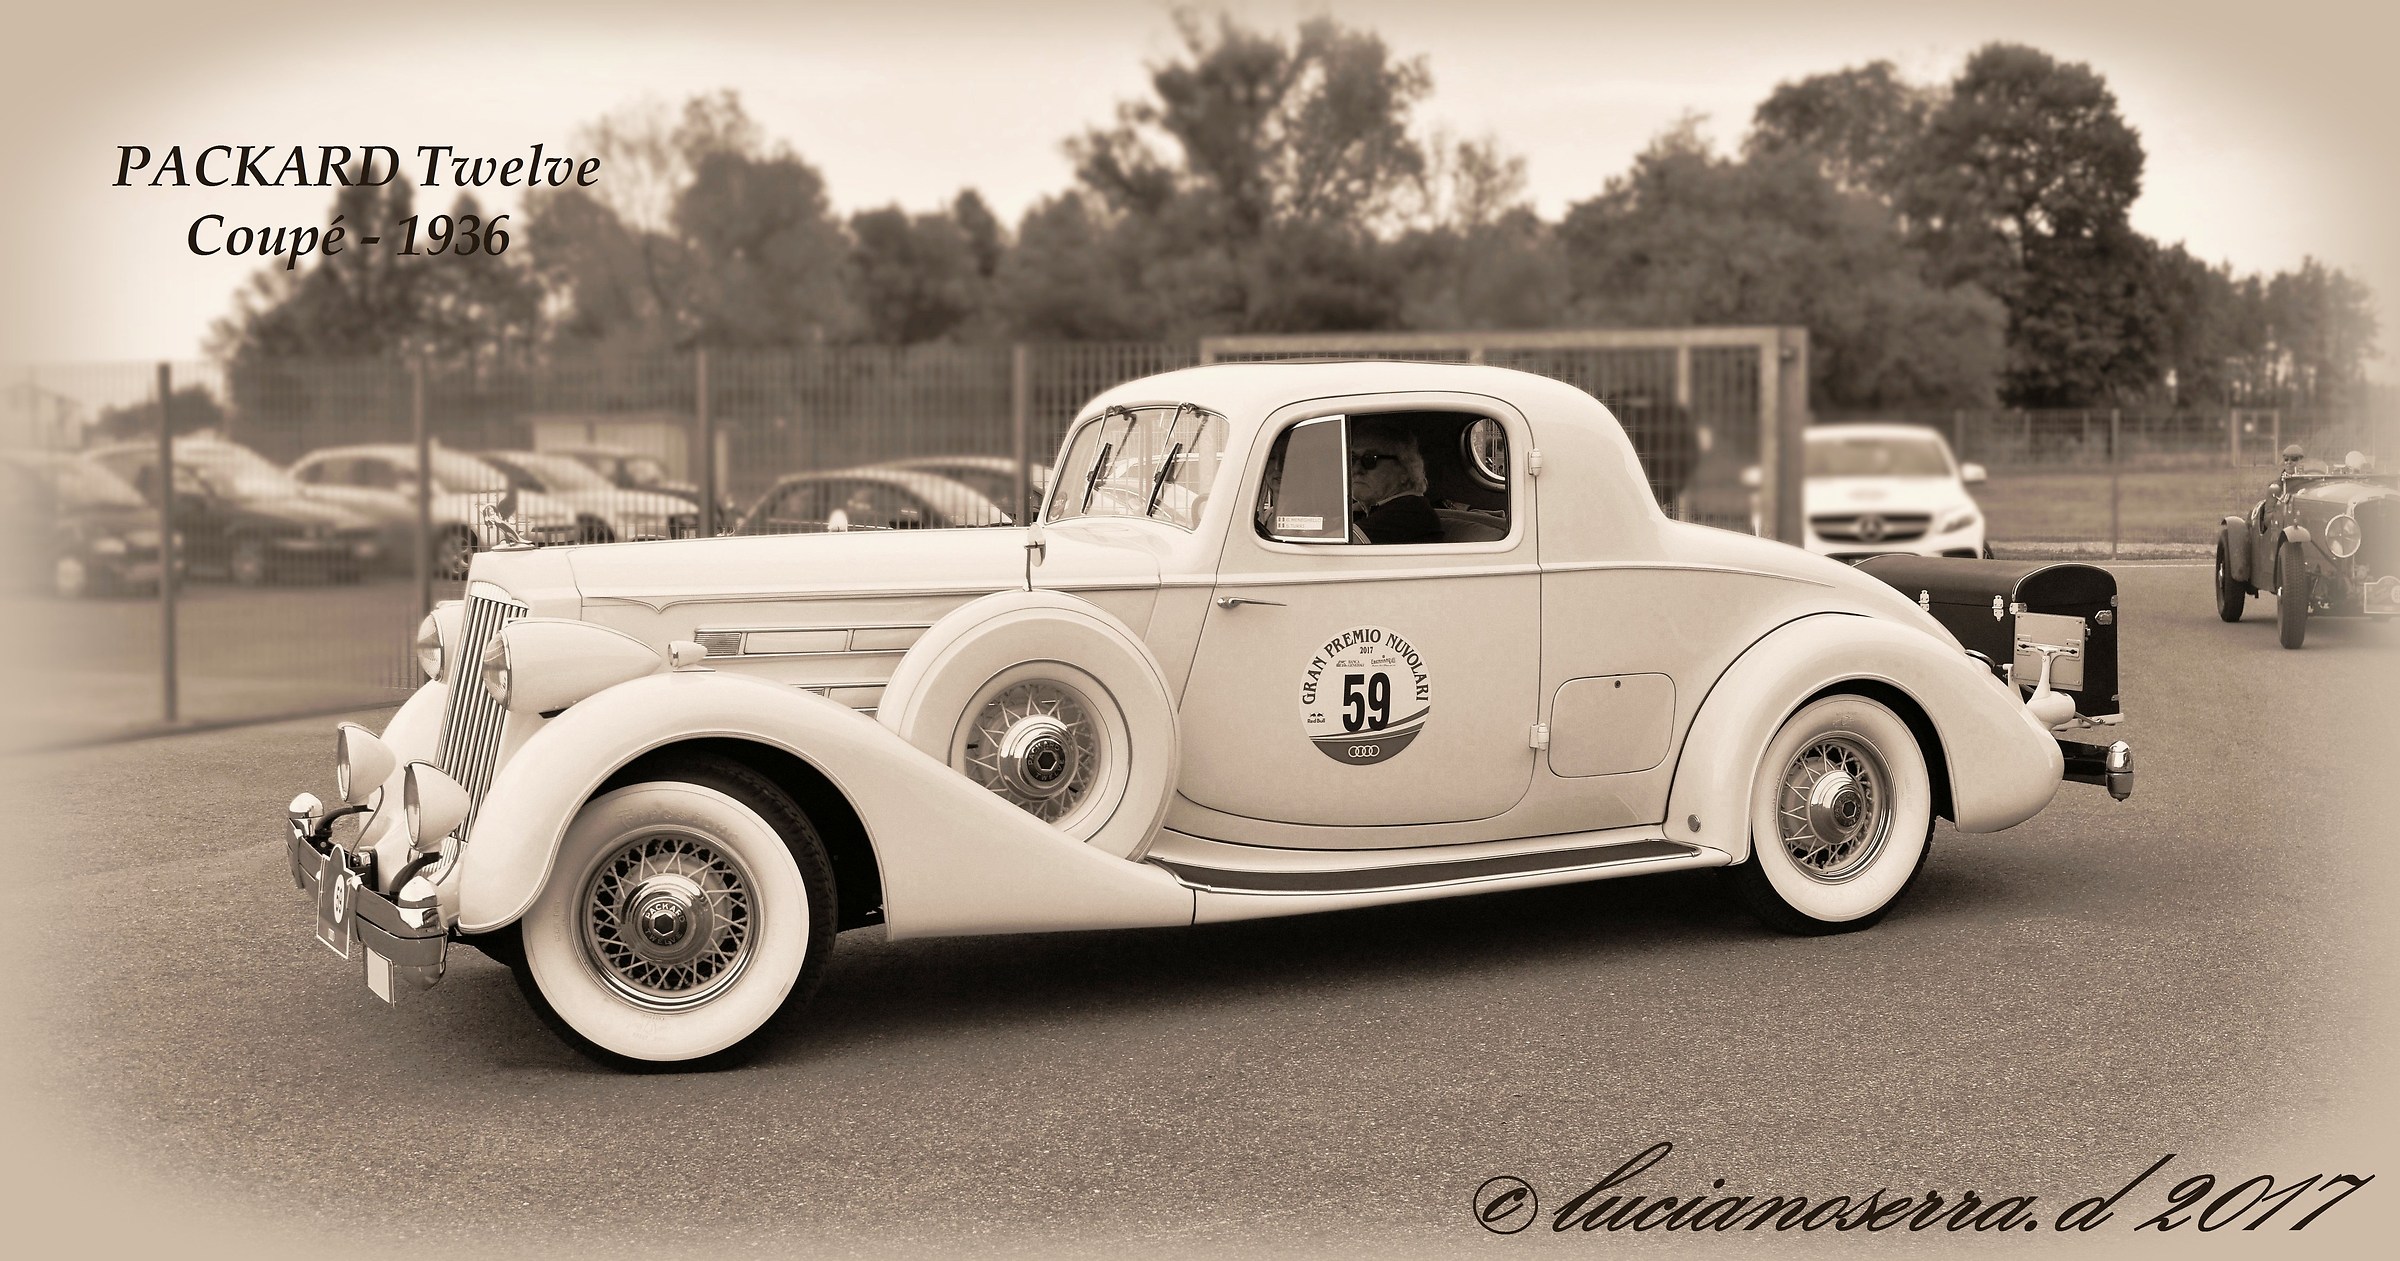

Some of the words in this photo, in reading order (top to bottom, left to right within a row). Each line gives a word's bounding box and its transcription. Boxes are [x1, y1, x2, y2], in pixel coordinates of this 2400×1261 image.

[1359, 646, 1374, 655] 2017
[1302, 656, 1327, 705] GRAN
[1323, 628, 1382, 659] PREMIO
[1385, 633, 1429, 702] NUVOLARI
[1342, 672, 1391, 733] 59
[644, 902, 687, 923] PACKARD
[645, 928, 684, 945] TWELVE
